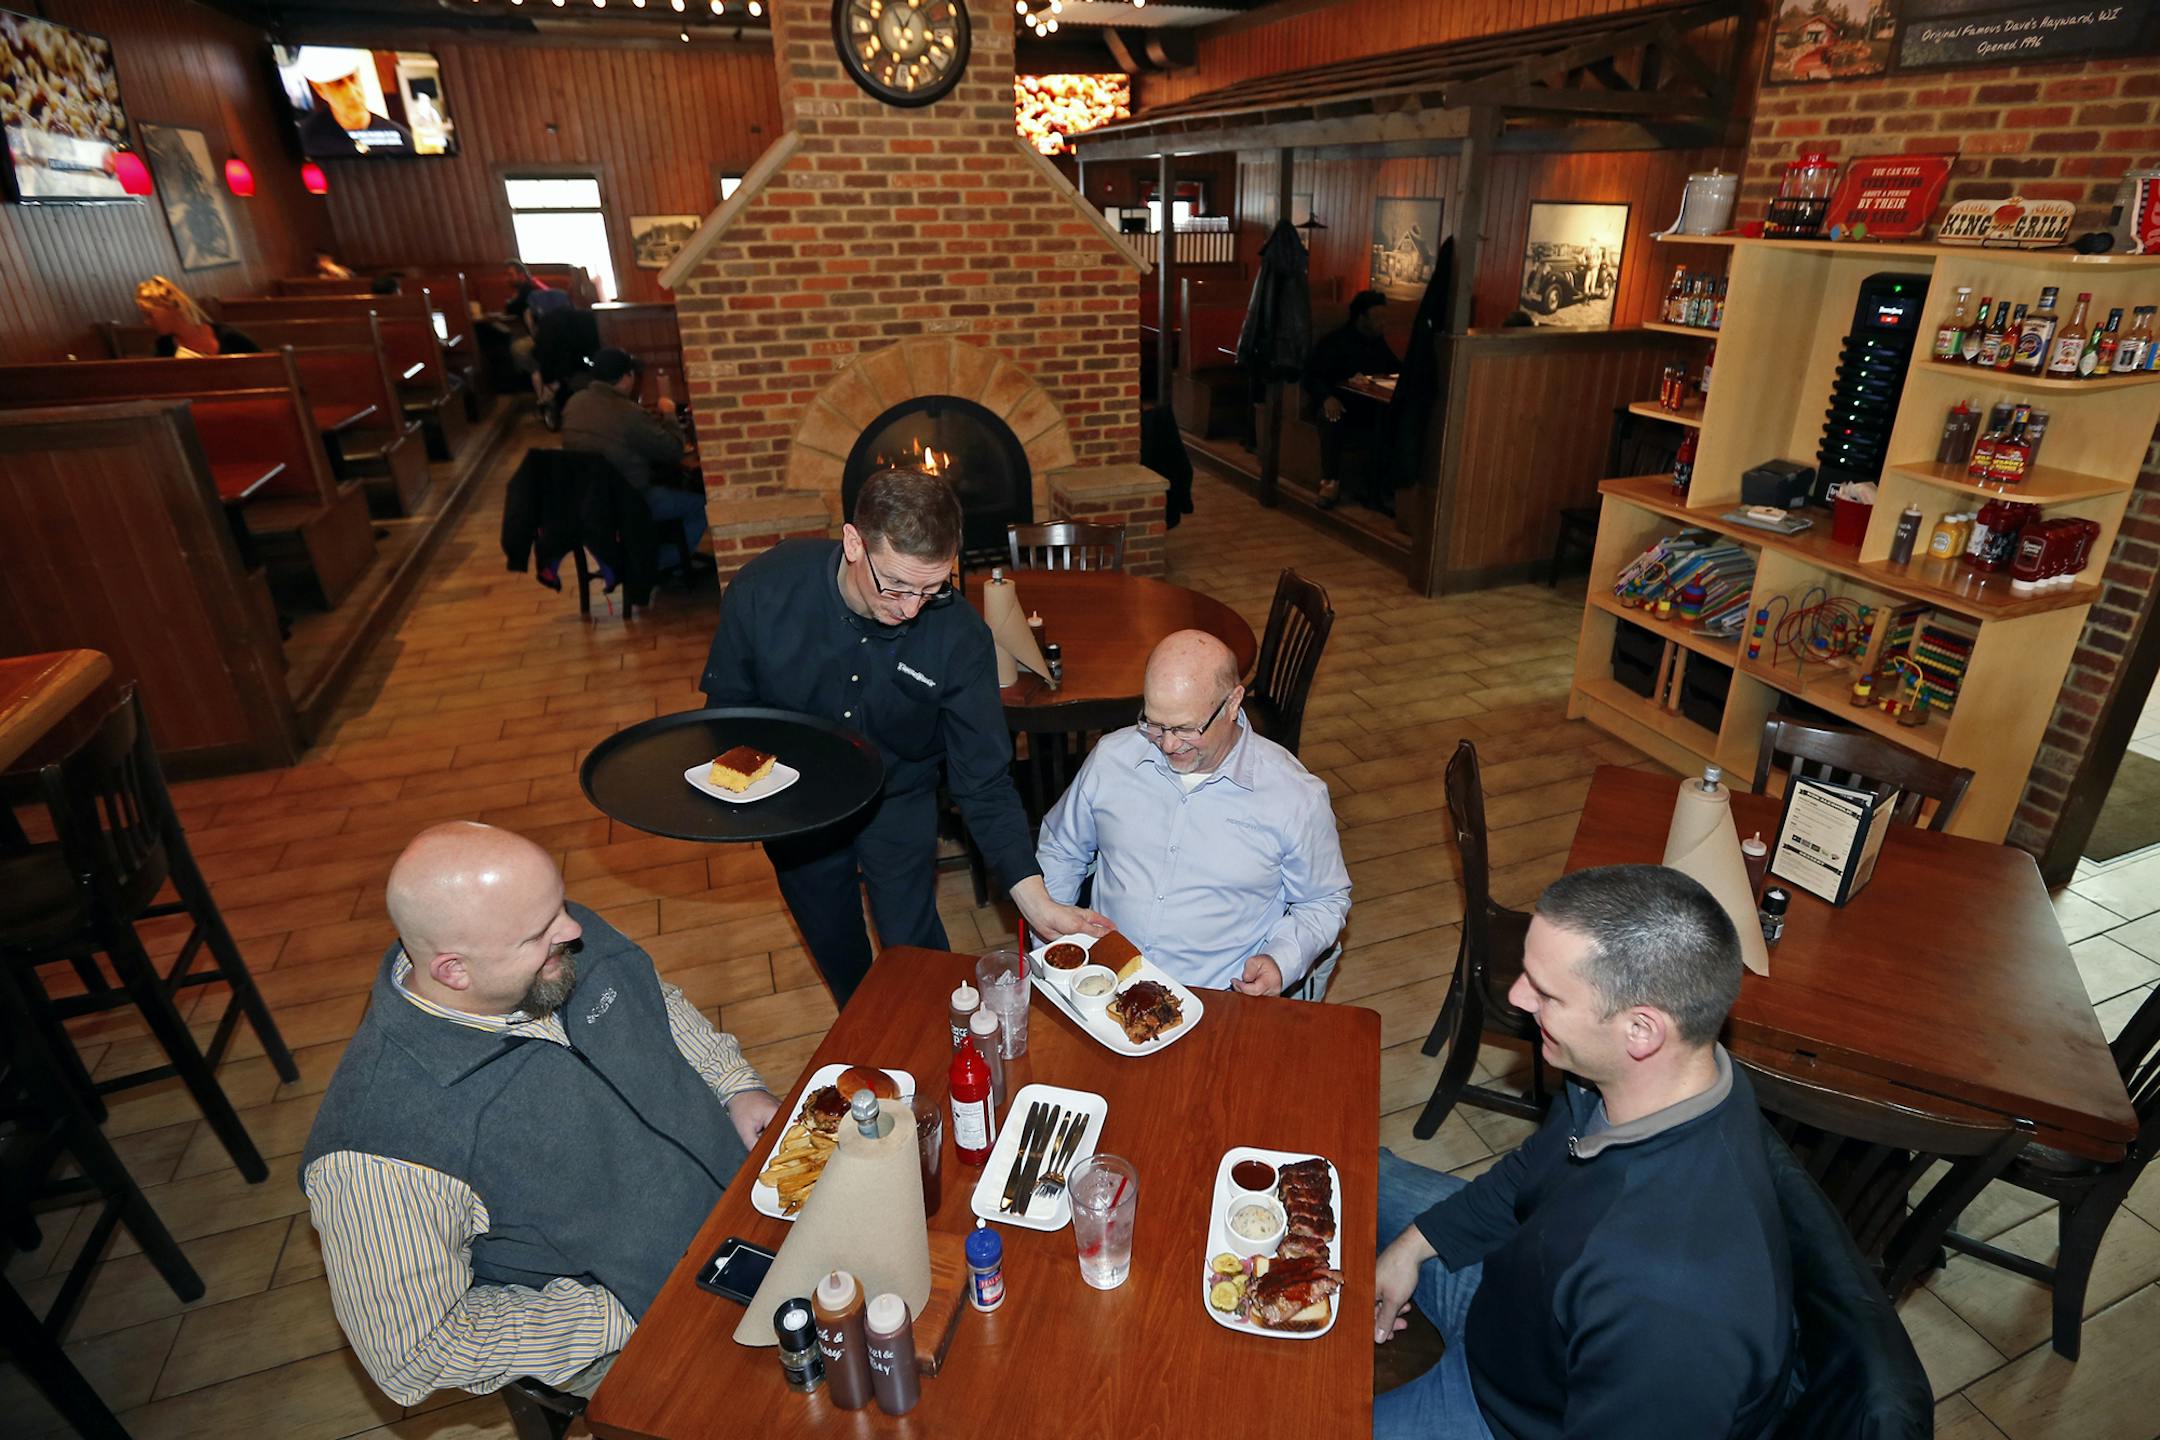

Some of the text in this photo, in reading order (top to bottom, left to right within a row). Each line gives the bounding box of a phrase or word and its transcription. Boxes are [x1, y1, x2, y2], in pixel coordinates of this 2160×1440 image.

[1961, 24, 2001, 37] Famous
[2004, 17, 2037, 33] Dave's
[2098, 7, 2123, 22] WI
[1976, 35, 2044, 57] Opened 1996
[1886, 167, 1902, 176] CAN
[1902, 166, 1920, 176] TELL
[1857, 198, 1907, 209] BY THEIR
[1940, 213, 2070, 239] KING GRILL
[833, 1331, 844, 1344] &
